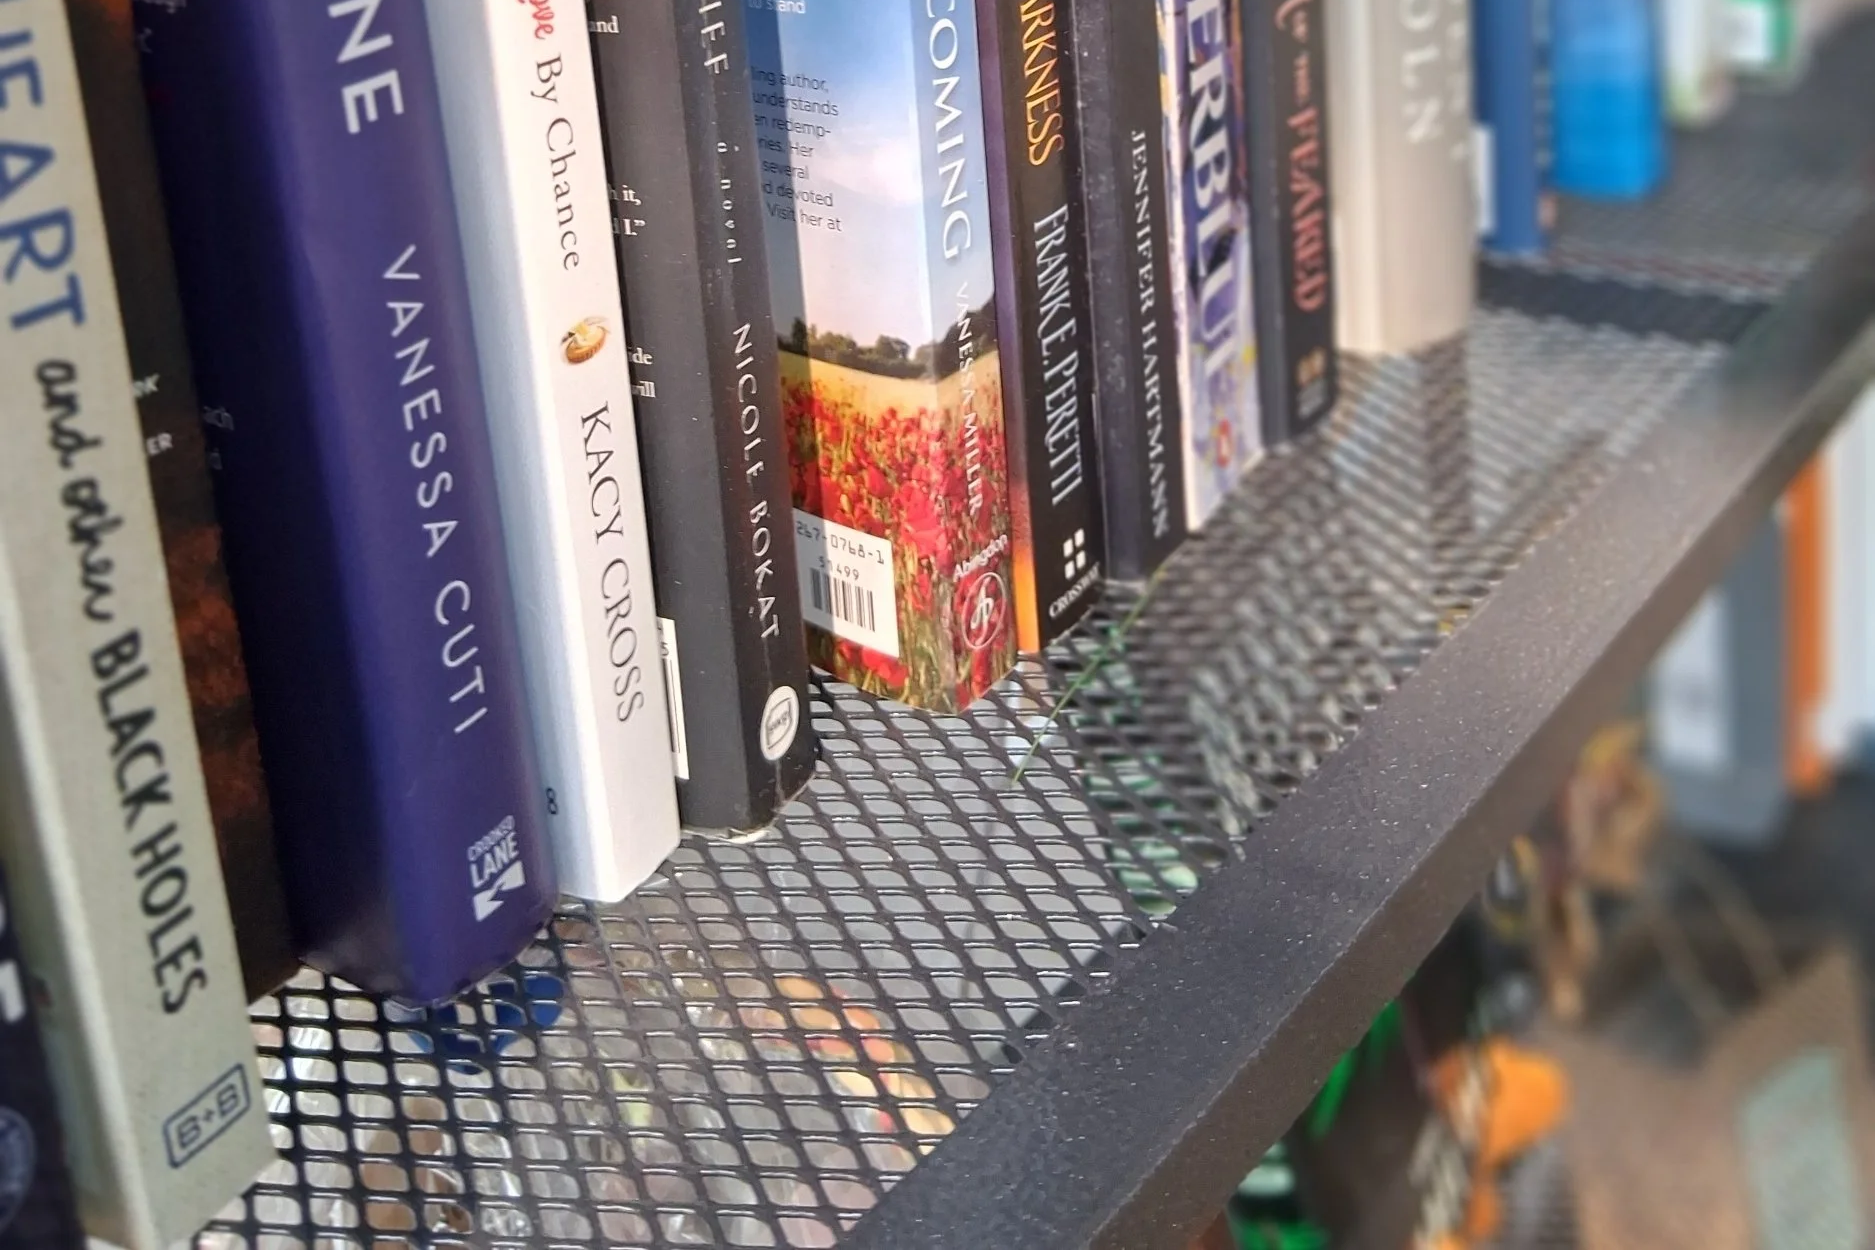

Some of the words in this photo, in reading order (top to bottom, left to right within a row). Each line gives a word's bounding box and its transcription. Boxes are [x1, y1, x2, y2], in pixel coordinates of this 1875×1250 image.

[530, 53, 563, 105] By
[753, 92, 839, 116] understands
[772, 117, 831, 141] redemp-
[779, 72, 830, 93] author,
[546, 116, 580, 271] Chance
[720, 179, 743, 264] novel
[762, 160, 810, 180] several
[766, 201, 797, 222] Visit
[799, 208, 824, 227] her
[826, 217, 842, 232] at
[776, 182, 834, 207] devoted
[1130, 129, 1157, 315] JENNIFER
[1033, 202, 1072, 338] FRANK
[954, 281, 979, 407] VANESSA
[35, 358, 103, 470] and
[580, 400, 624, 545] KACY
[1044, 350, 1084, 507] PERETTI
[382, 244, 459, 558] VANESSA
[434, 579, 488, 735] CUTI
[733, 323, 766, 482] NICOLE
[750, 500, 781, 639] BOKAT
[61, 477, 125, 623] other
[600, 557, 644, 723] CROSS
[89, 627, 173, 830] BLACK
[130, 821, 207, 1015] HOLES
[470, 831, 520, 889] LANE
[175, 1081, 241, 1150] B+B
